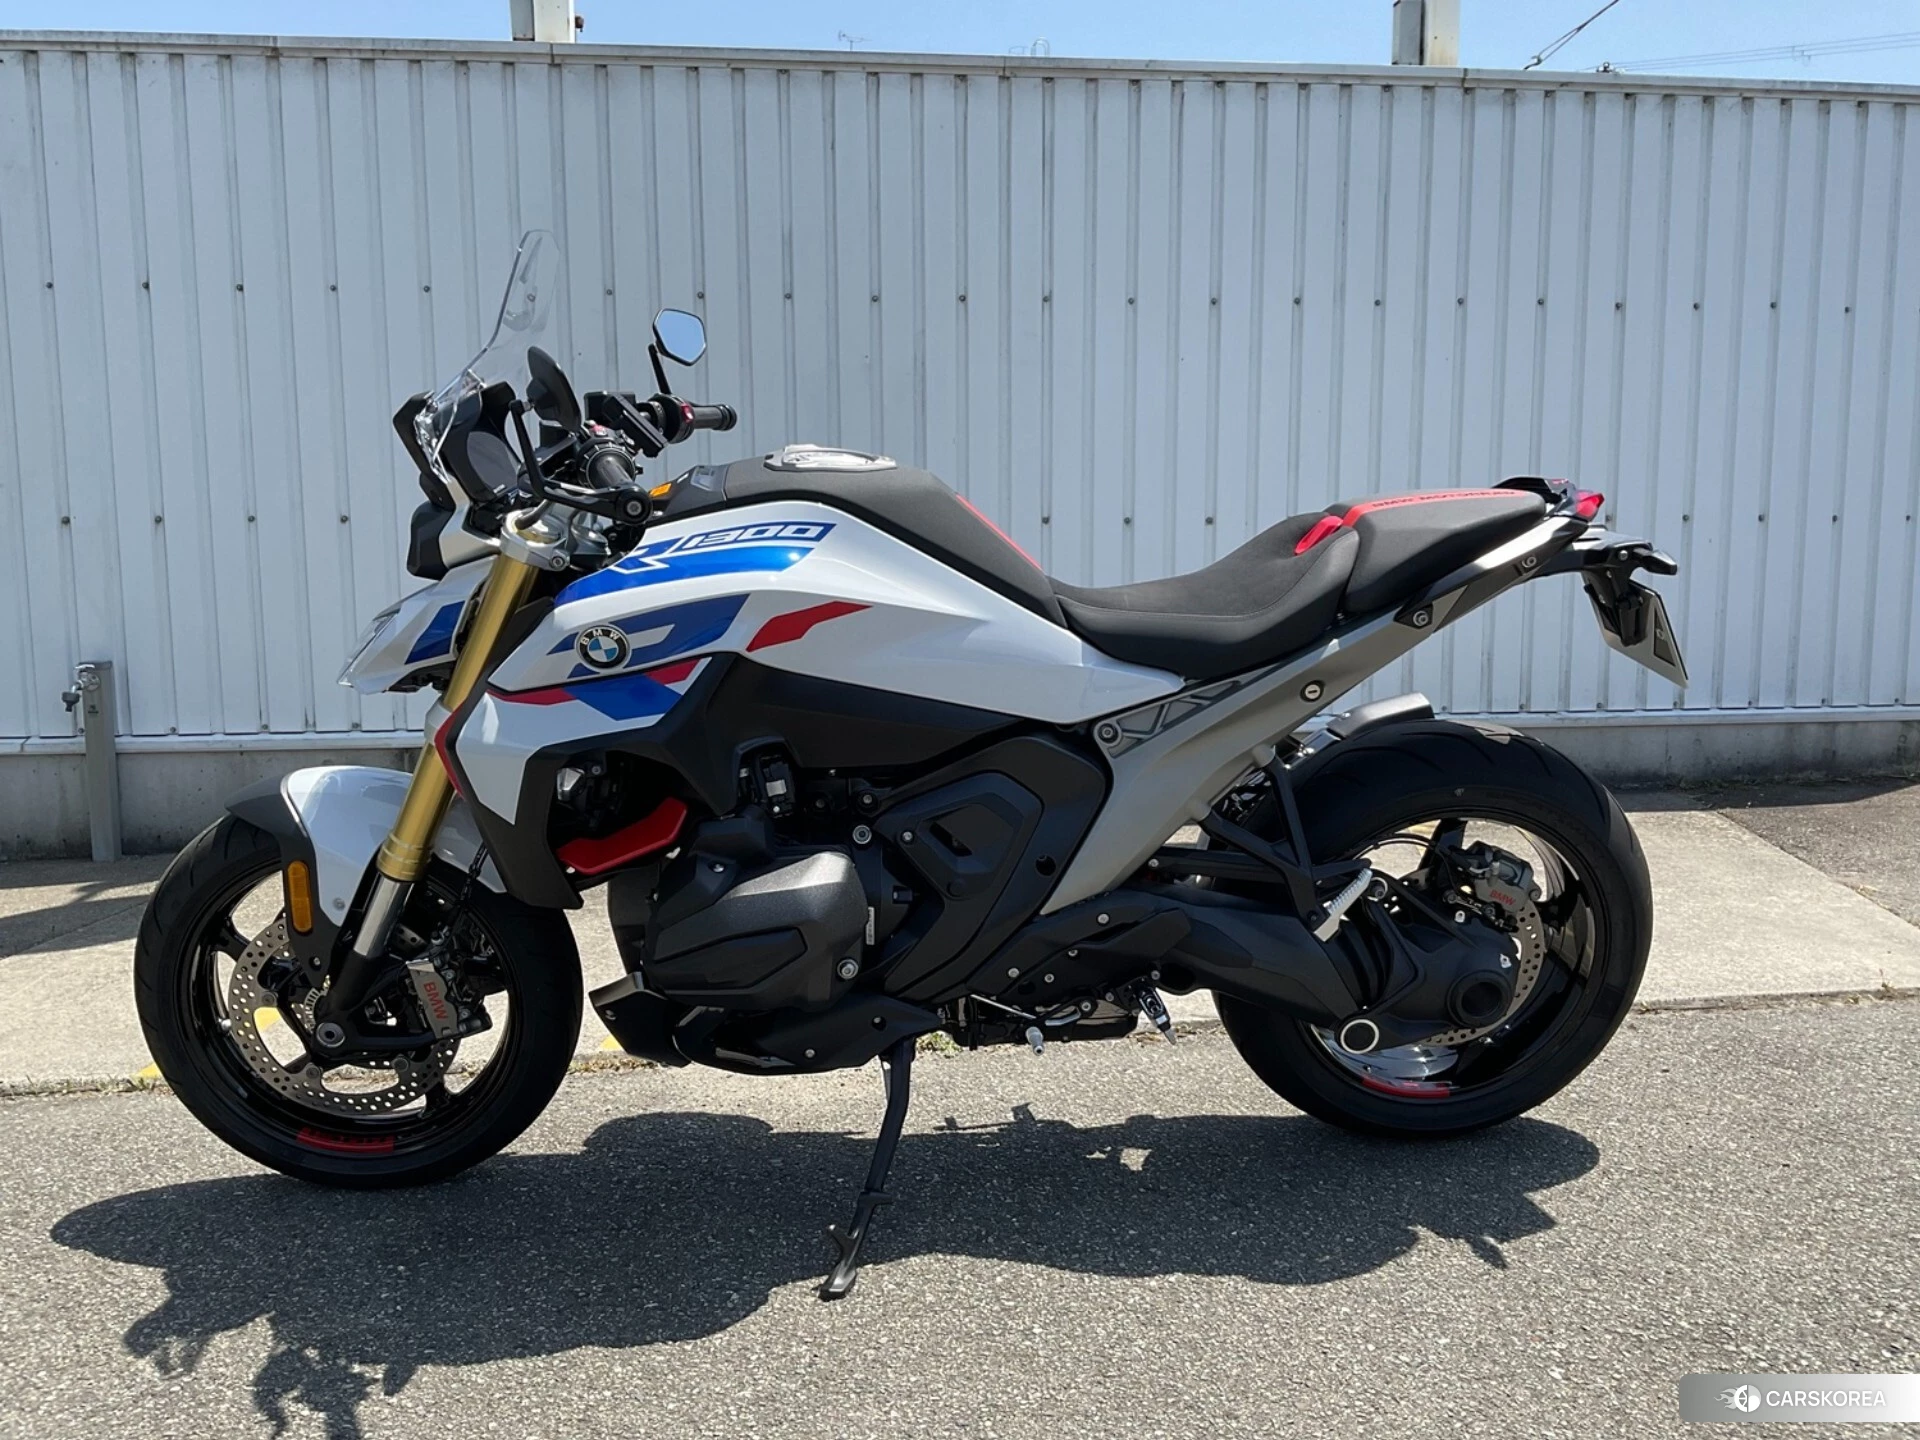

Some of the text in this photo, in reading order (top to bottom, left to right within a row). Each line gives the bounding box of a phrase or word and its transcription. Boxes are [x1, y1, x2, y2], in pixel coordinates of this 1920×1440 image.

[682, 524, 825, 550] 1300
[580, 629, 620, 645] BMW
[1489, 889, 1515, 905] BMW
[423, 982, 448, 1019] BMW
